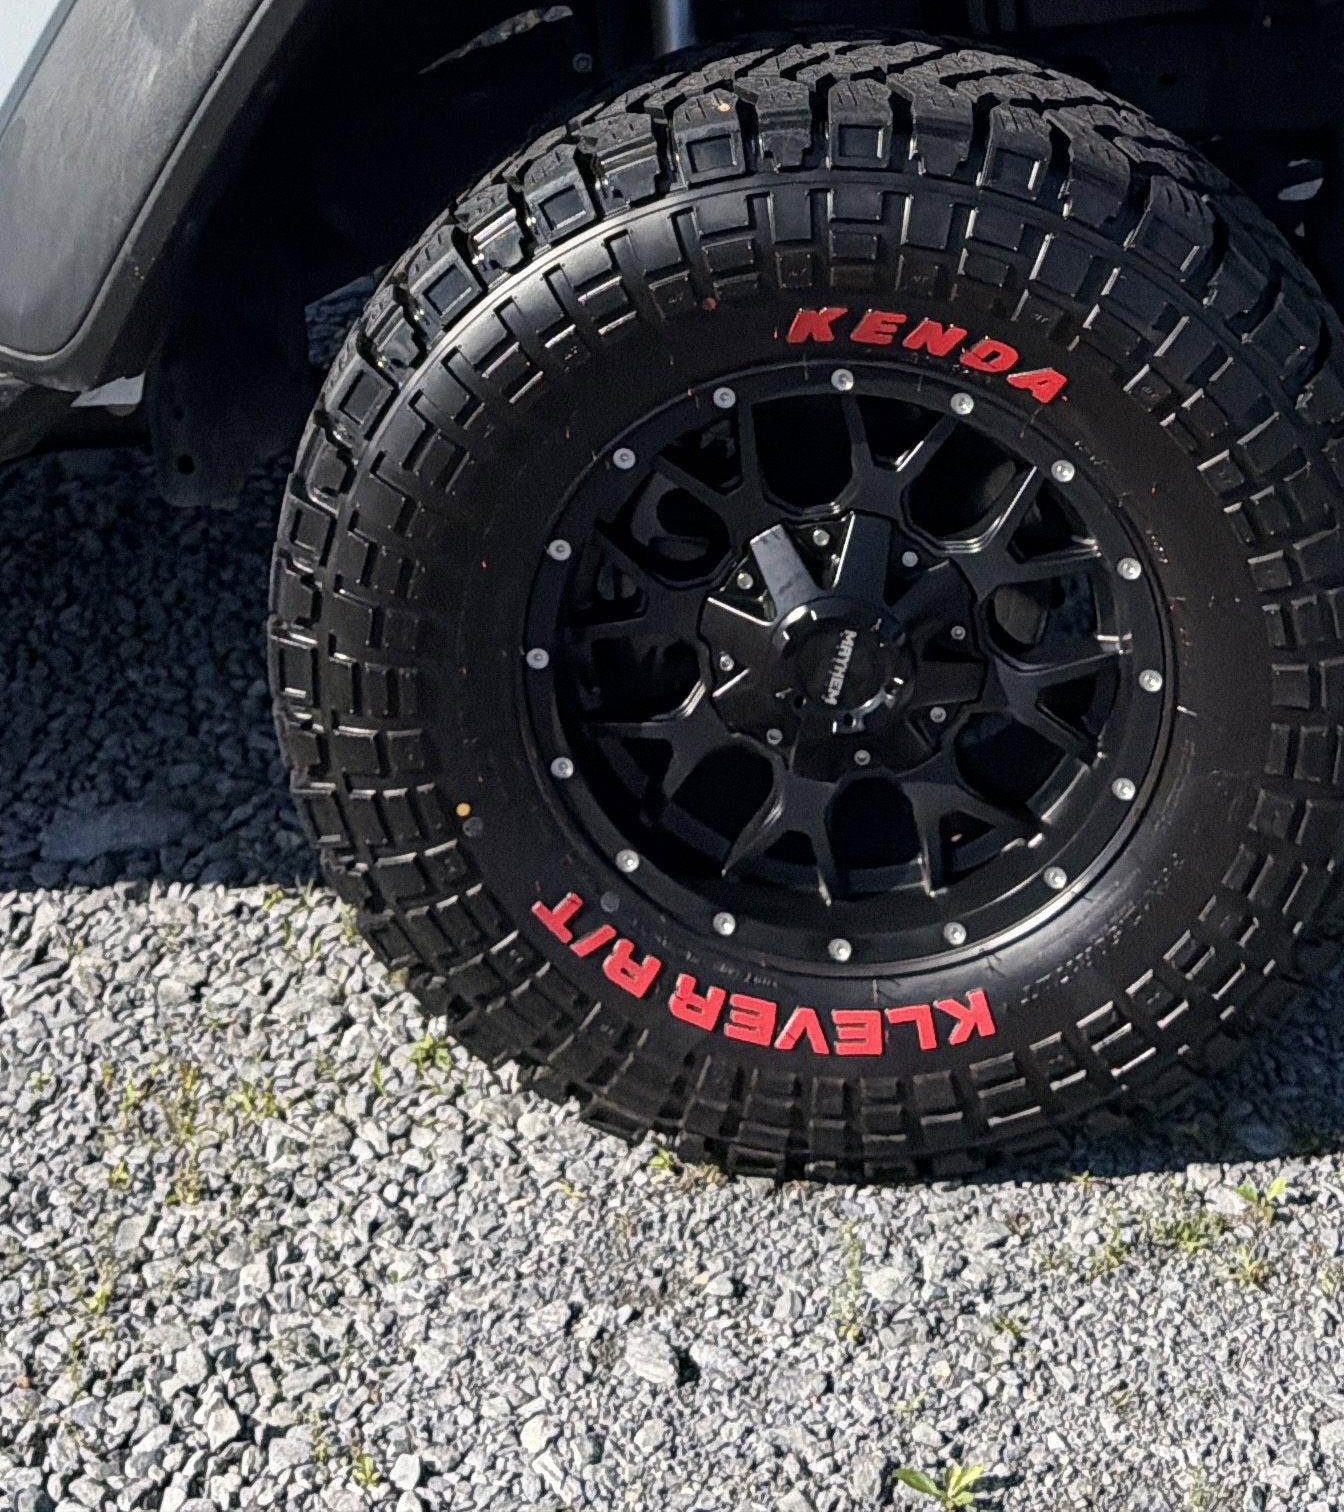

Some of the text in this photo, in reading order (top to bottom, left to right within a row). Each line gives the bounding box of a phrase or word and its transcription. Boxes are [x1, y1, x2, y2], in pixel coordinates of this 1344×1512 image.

[786, 306, 1068, 404] KENDA
[821, 629, 857, 705] MAYHEM
[531, 892, 662, 999] R/T
[668, 972, 997, 1056] KLEVER
